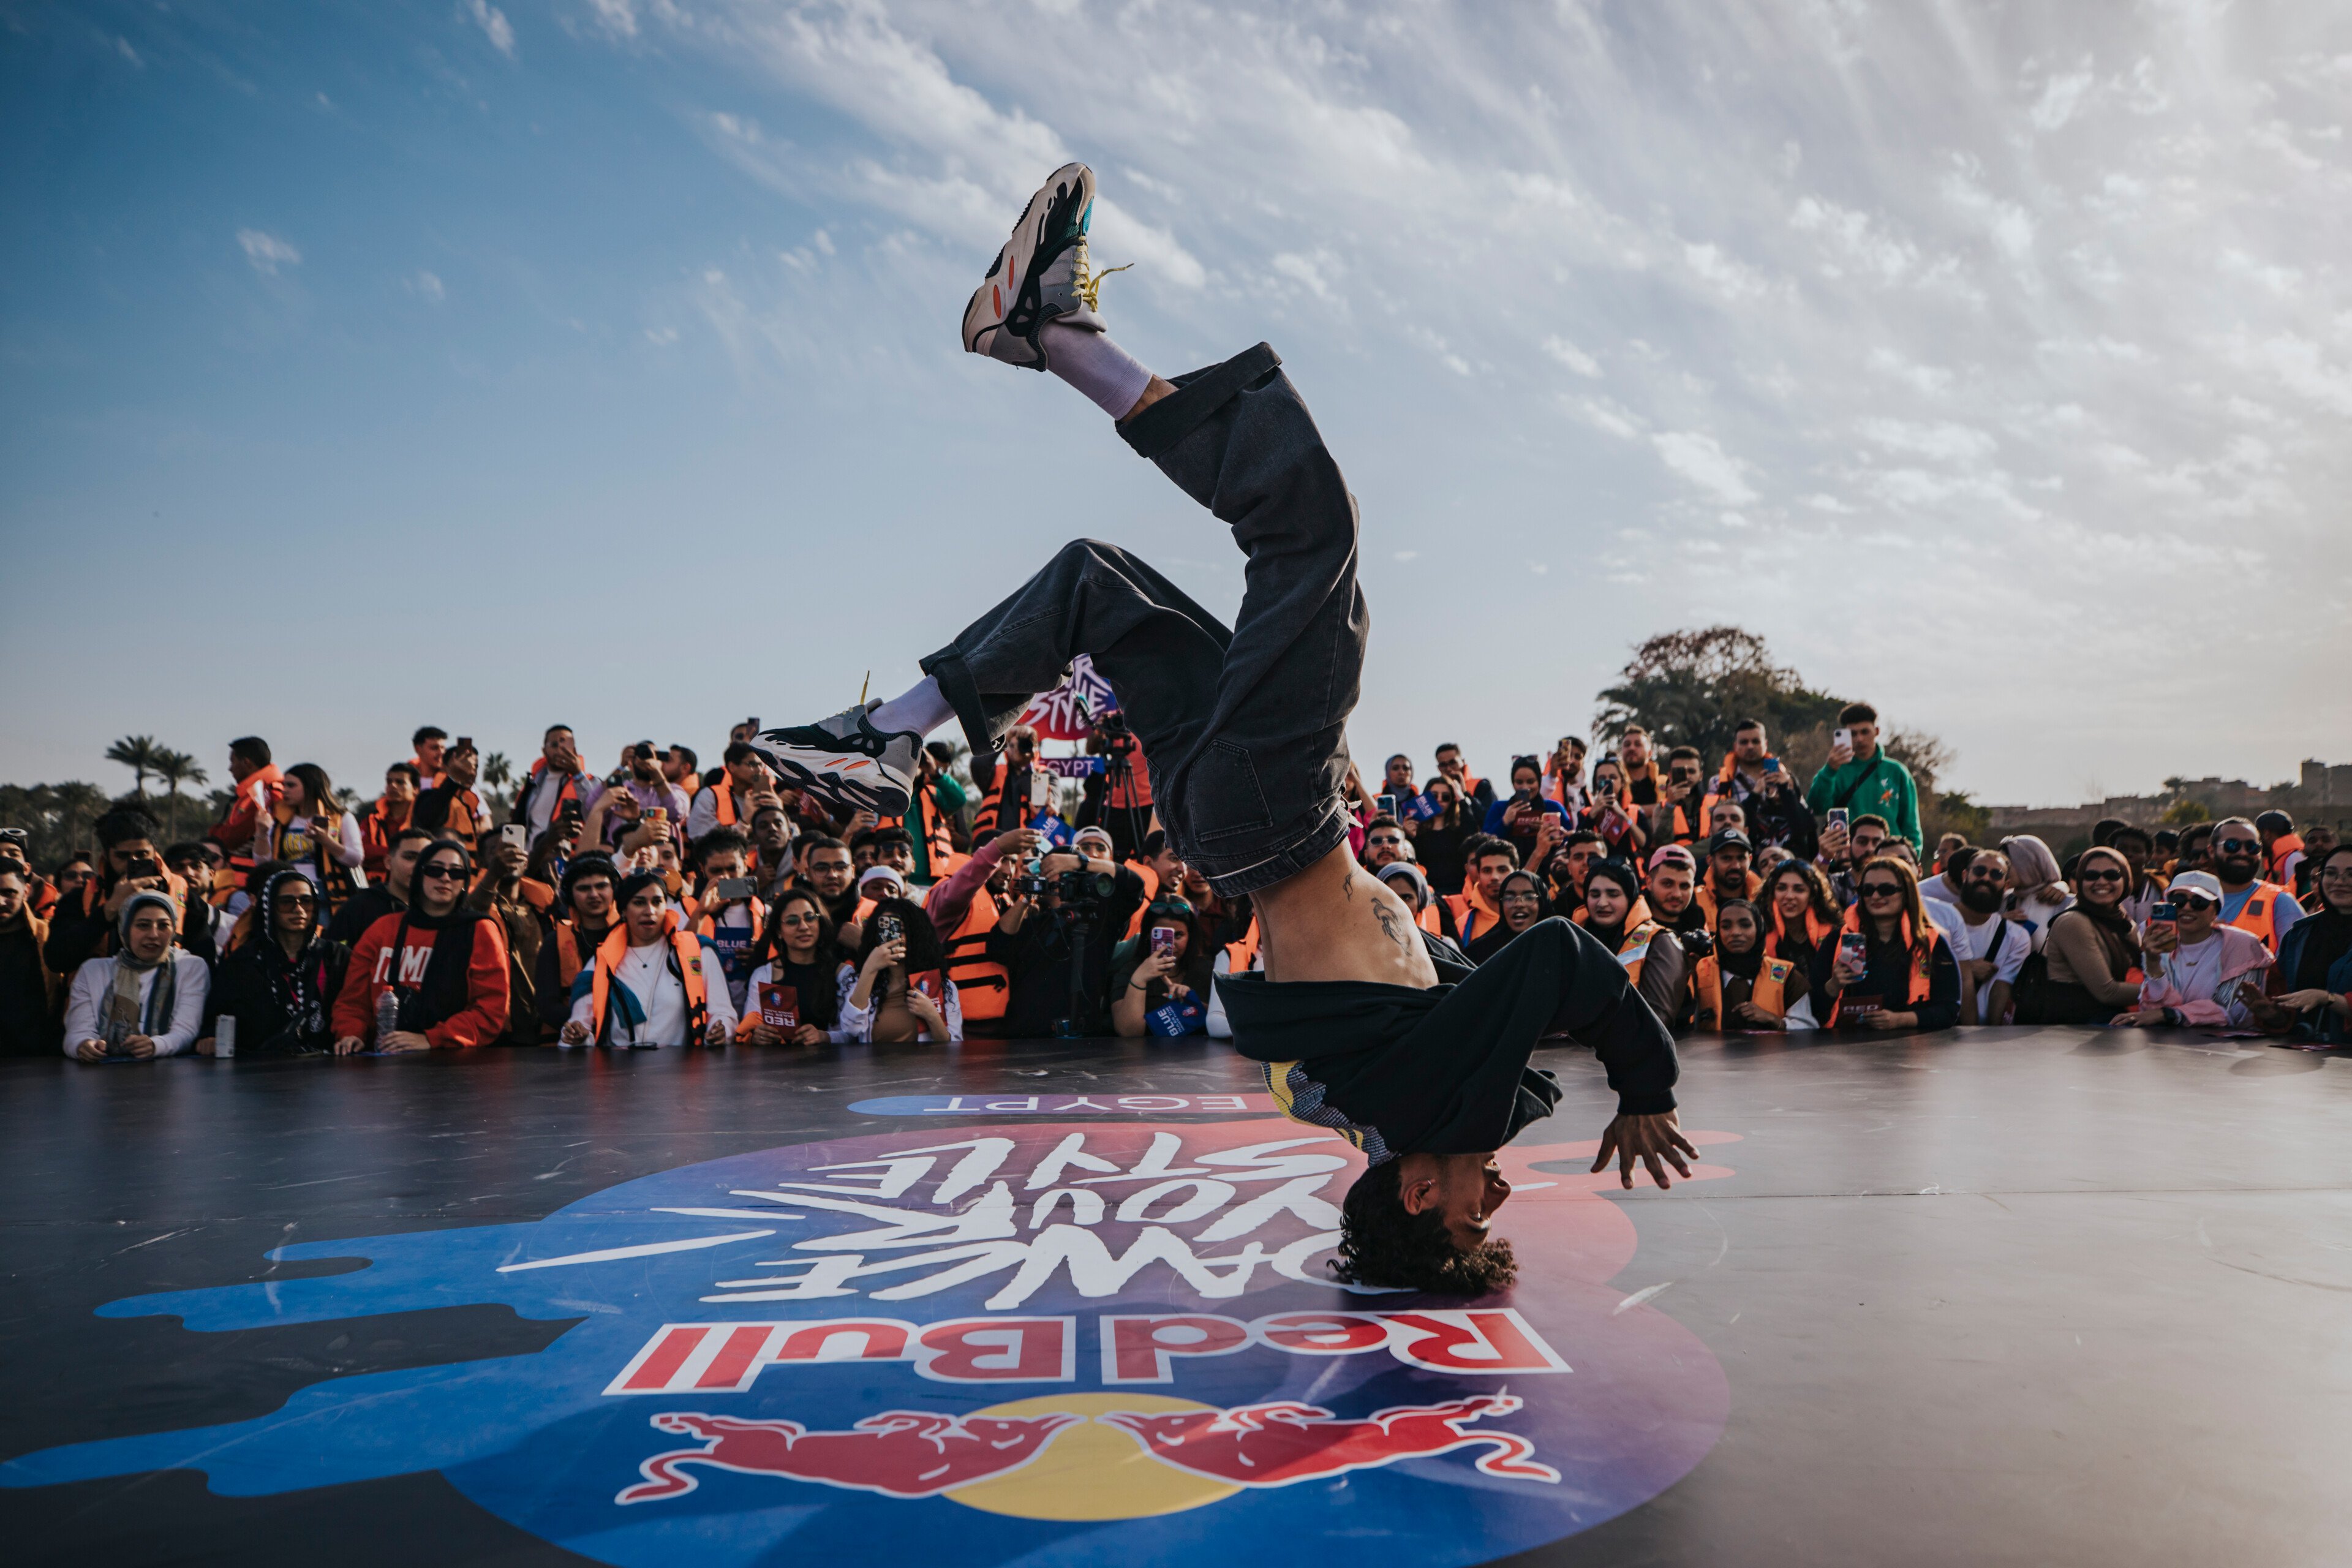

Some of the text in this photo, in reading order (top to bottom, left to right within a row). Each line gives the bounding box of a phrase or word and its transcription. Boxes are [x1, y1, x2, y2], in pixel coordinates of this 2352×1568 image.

[1038, 760, 1095, 776] GYPT
[717, 940, 747, 949] BLUE
[764, 1015, 795, 1027] RED
[1157, 1009, 1179, 1036] BLUE
[922, 1095, 1248, 1113] EGYPT
[778, 1131, 1348, 1204] STYLE
[601, 1316, 1077, 1396] Bull
